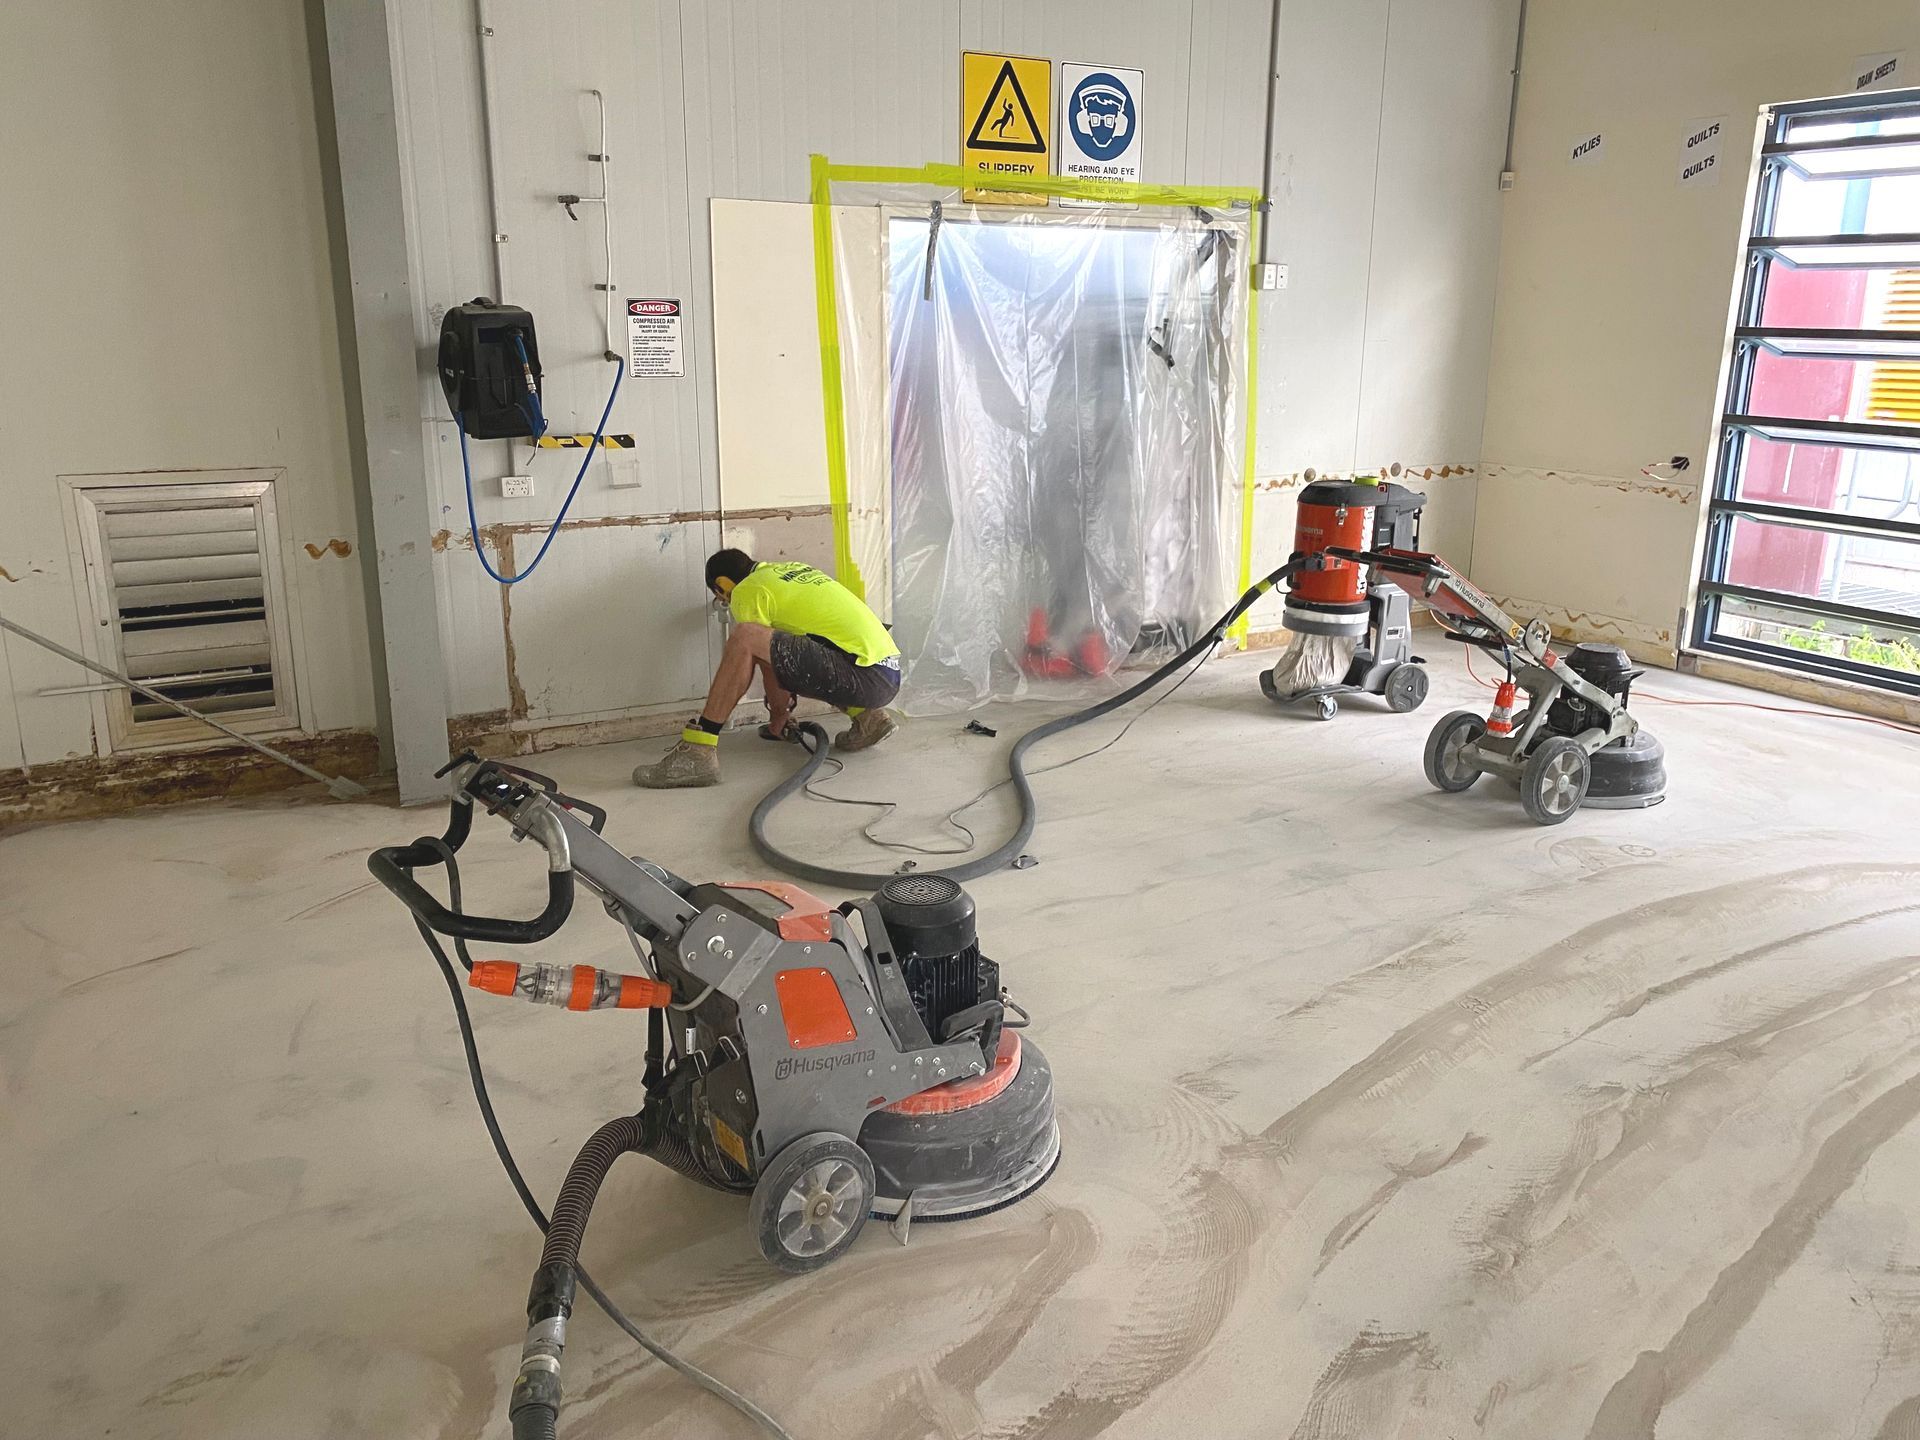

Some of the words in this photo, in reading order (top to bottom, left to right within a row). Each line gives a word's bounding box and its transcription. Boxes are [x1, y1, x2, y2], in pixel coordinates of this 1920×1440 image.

[1875, 58, 1897, 81] SHEETS
[1572, 134, 1602, 160] KYLIES
[1687, 123, 1720, 148] QUILTS
[978, 161, 1035, 176] SLIPPERY
[1068, 164, 1101, 174] HEARING
[1103, 166, 1119, 175] AND
[1121, 167, 1135, 176] EYE
[1682, 155, 1716, 180] QUILTS
[1079, 175, 1125, 185] PROTECTION
[636, 304, 672, 312] DANGER
[1459, 584, 1485, 609] Husqvarna
[793, 1049, 876, 1074] Husqvarna
